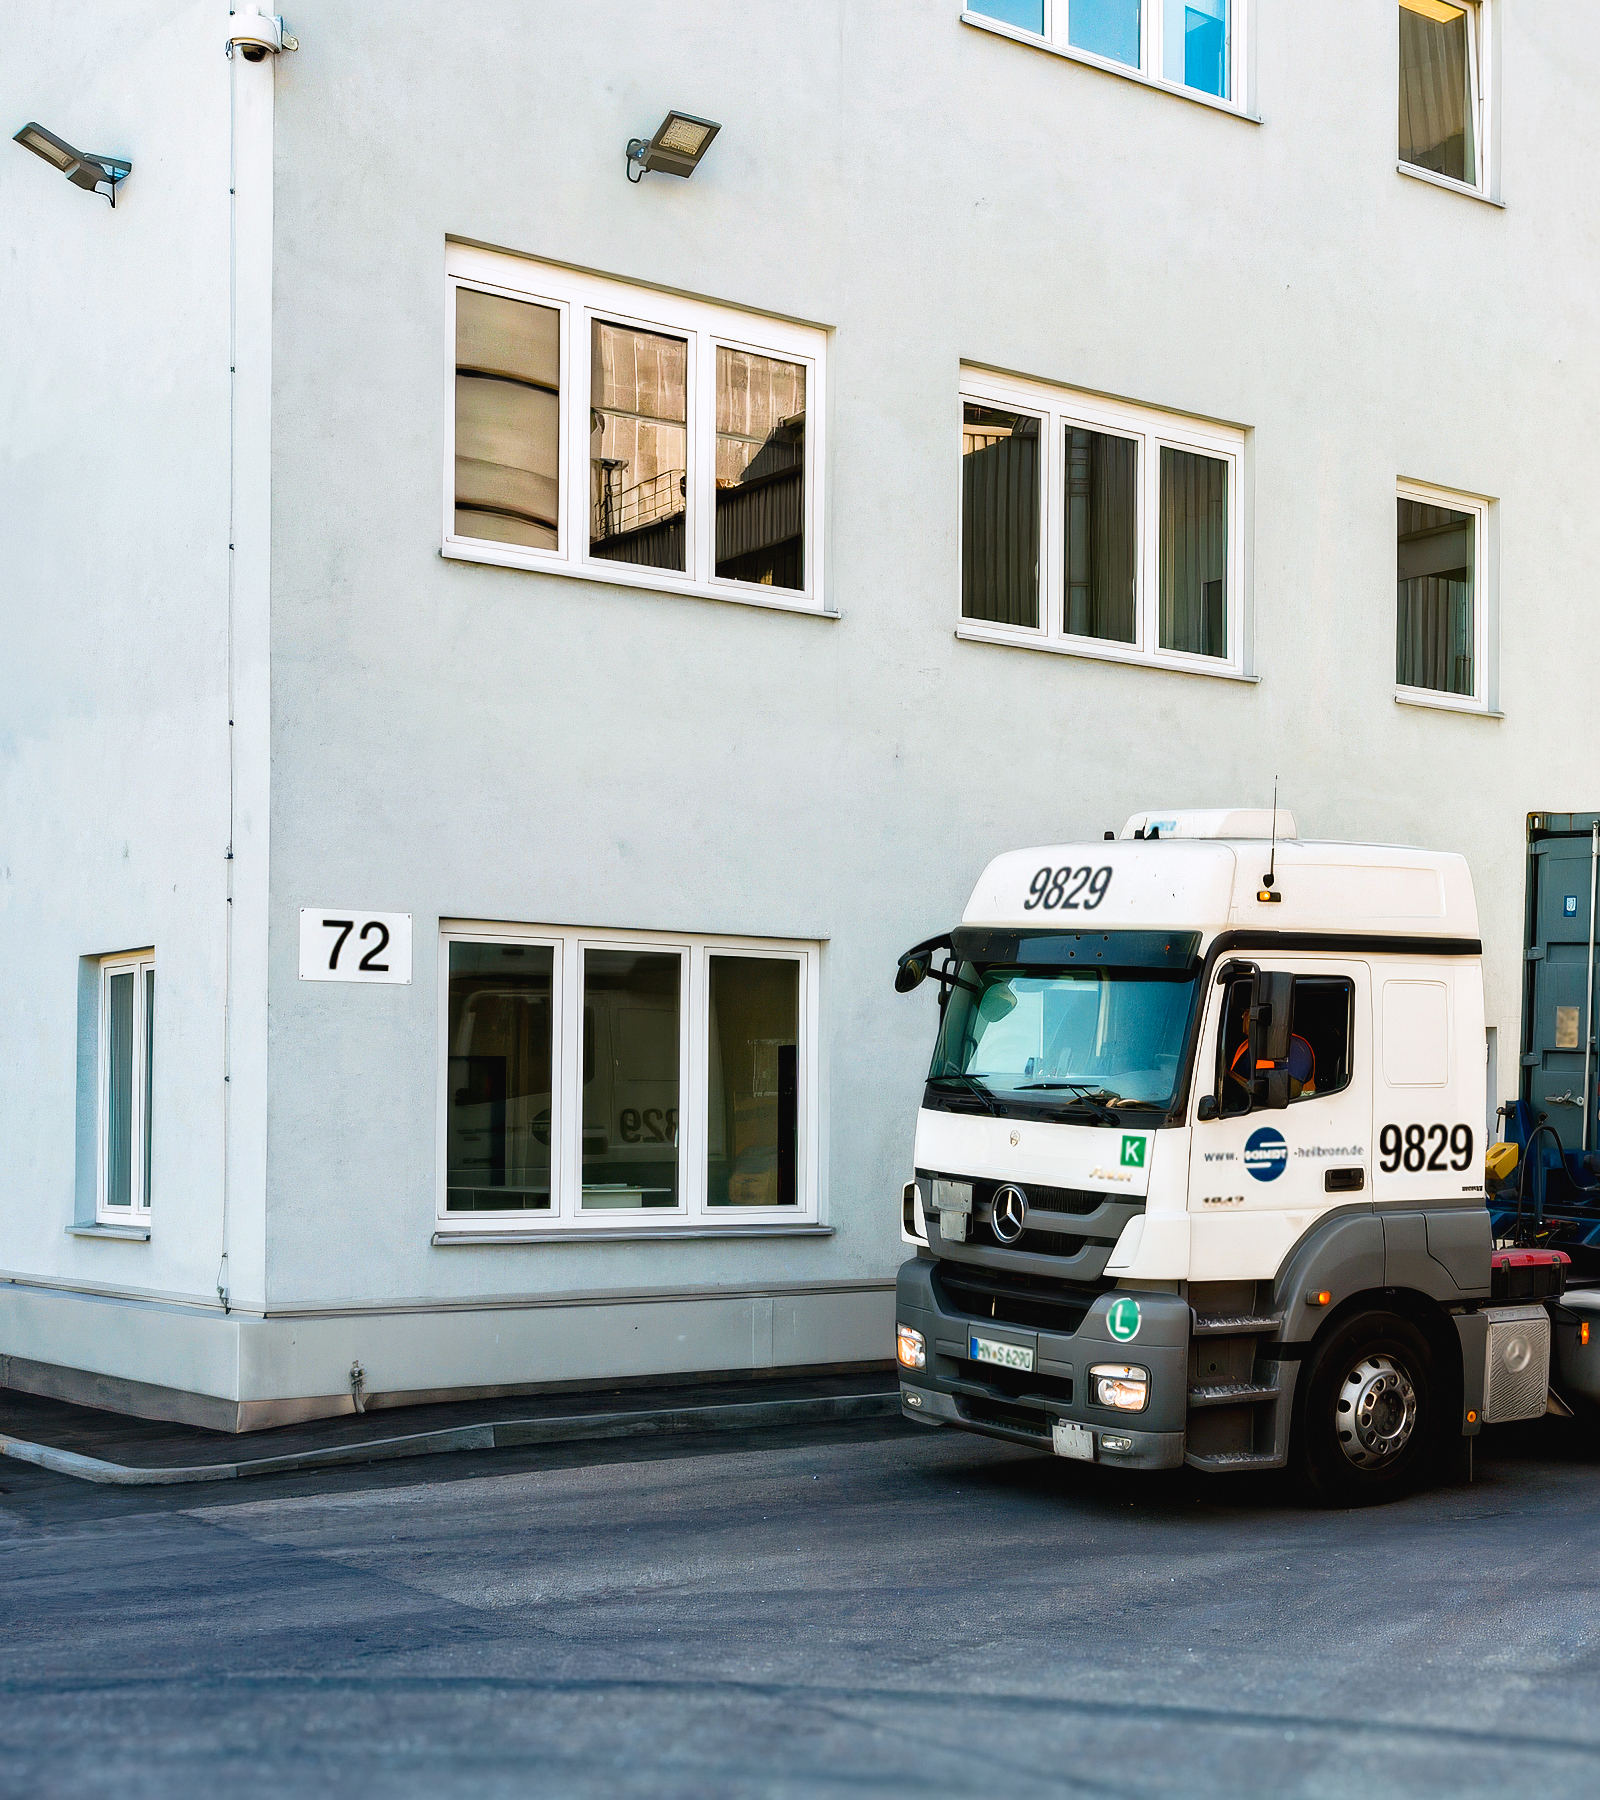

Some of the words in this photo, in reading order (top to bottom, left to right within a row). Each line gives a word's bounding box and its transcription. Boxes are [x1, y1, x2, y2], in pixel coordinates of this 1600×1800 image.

[1024, 866, 1113, 910] 9829
[322, 919, 390, 972] 72
[1125, 1140, 1140, 1162] K
[1380, 1123, 1474, 1173] 9829
[1115, 1304, 1130, 1334] L
